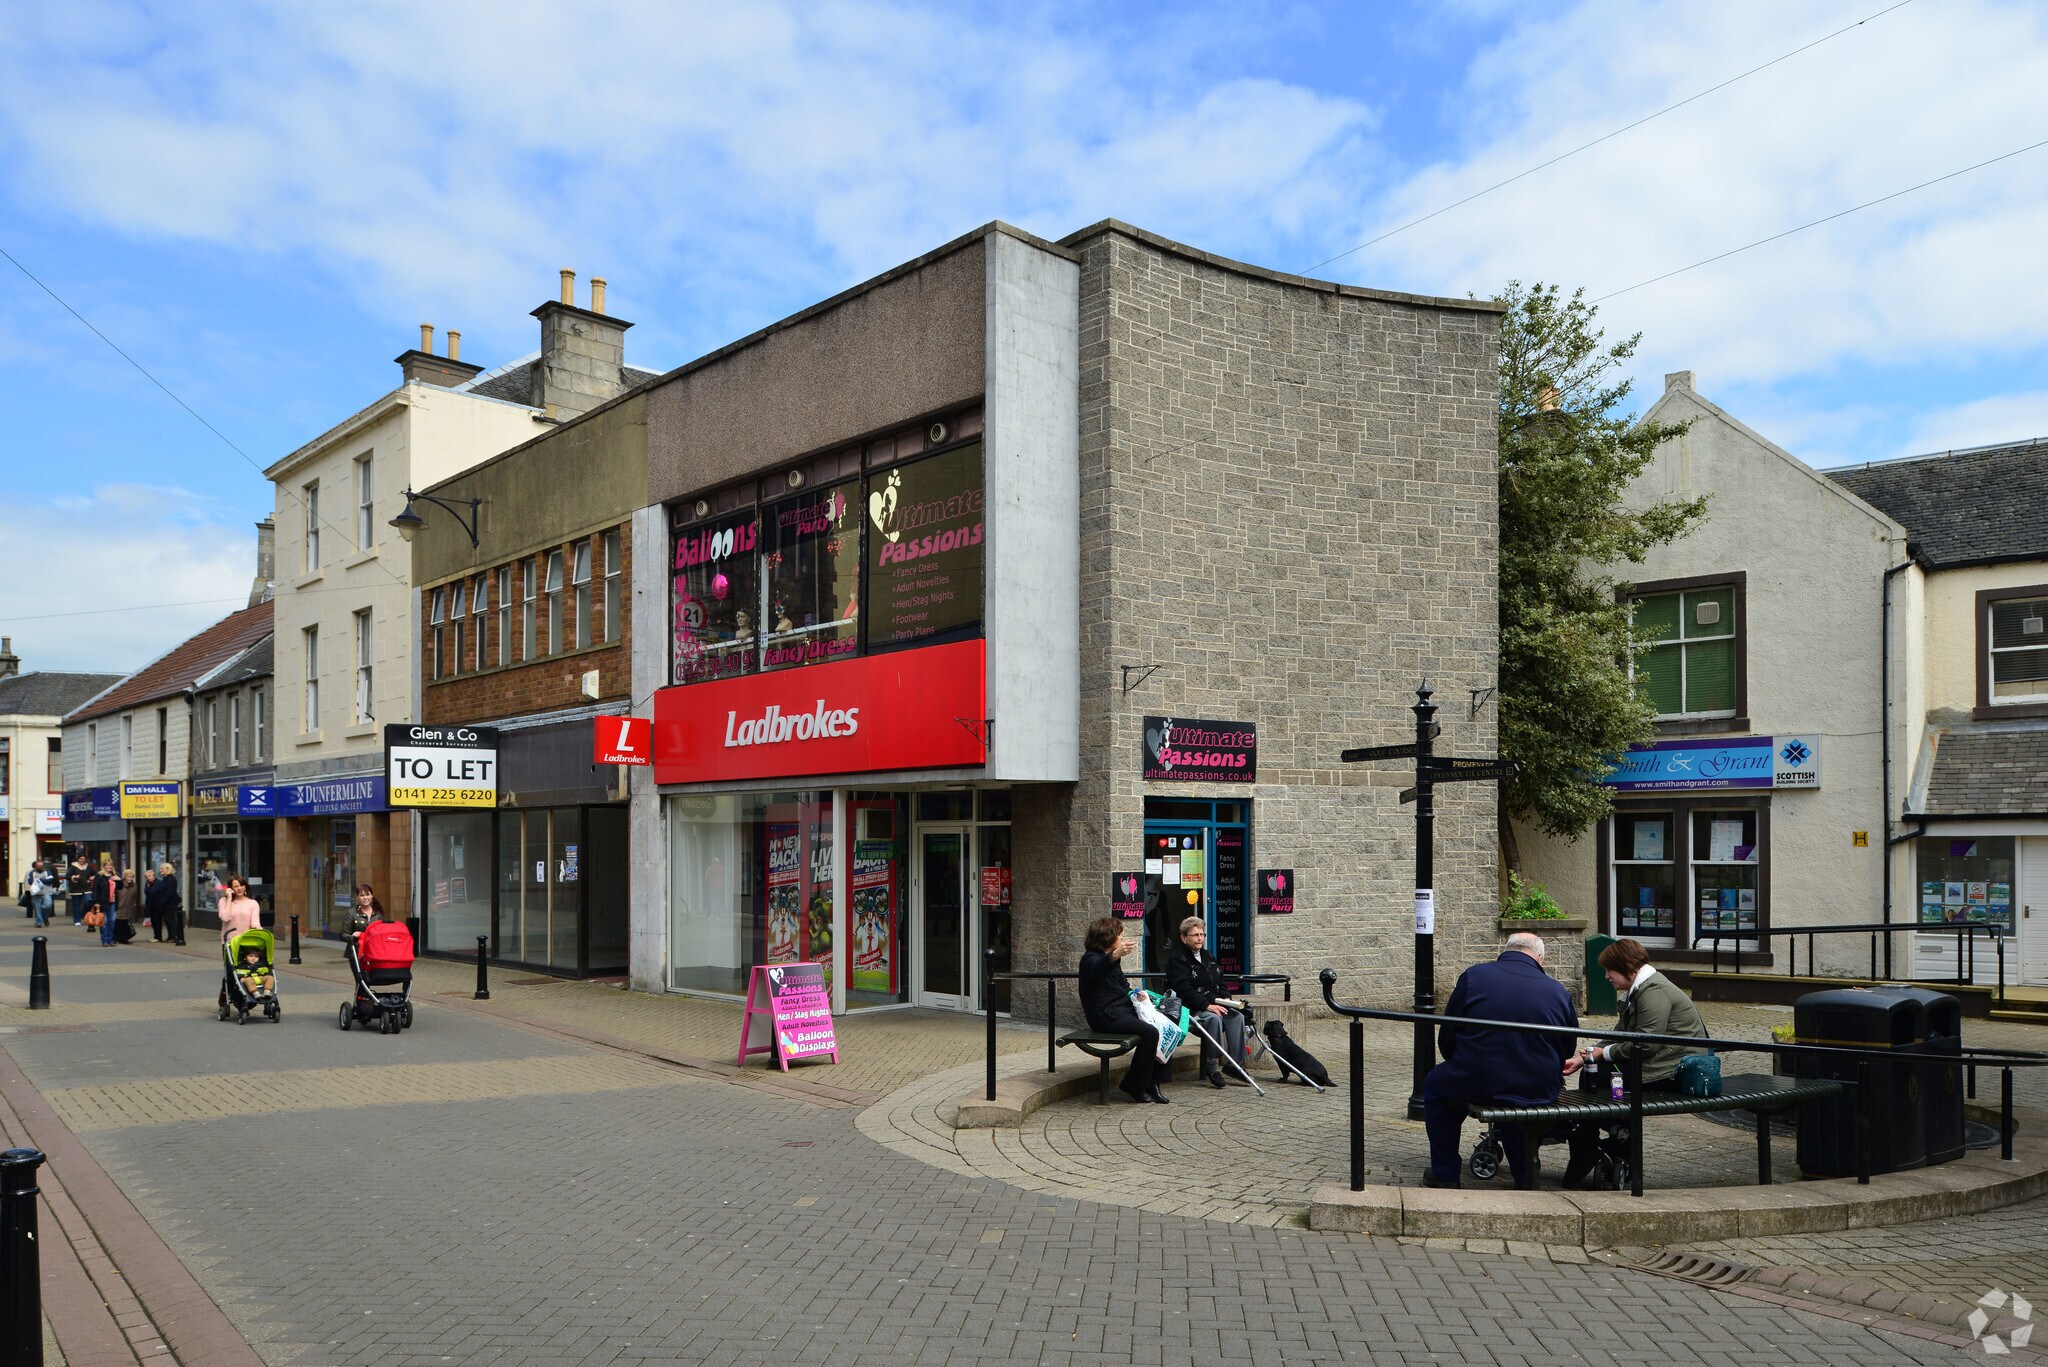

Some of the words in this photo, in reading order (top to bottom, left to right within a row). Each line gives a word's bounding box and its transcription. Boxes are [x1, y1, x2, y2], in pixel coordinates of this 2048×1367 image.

[778, 501, 831, 528] Ultimate
[882, 489, 983, 534] Ultimate
[797, 517, 829, 537] Party
[675, 520, 756, 570] Balloons
[879, 523, 983, 566] Passions
[896, 567, 918, 578] Fancy
[918, 561, 939, 573] Dress
[896, 581, 915, 593] Adult
[916, 575, 950, 589] Novelties
[896, 595, 929, 609] Hen/Stag
[930, 591, 954, 604] Nights
[684, 608, 699, 623] 21
[895, 612, 929, 624] Footwear
[895, 628, 914, 640] Party
[915, 625, 935, 637] Plans
[764, 644, 806, 666] Fancy
[808, 635, 856, 659] Dress
[675, 659, 707, 681] 01333
[708, 656, 723, 675] 30
[725, 654, 739, 672] 40
[724, 699, 860, 748] Ladbrokes
[409, 727, 442, 740] Glen
[447, 731, 455, 741] &
[457, 728, 478, 742] Co
[616, 720, 634, 752] L
[1168, 727, 1254, 748] Ultimate
[604, 753, 646, 764] Ladbrokes
[1158, 748, 1247, 767] Passions
[1667, 752, 1695, 773] &
[1698, 750, 1770, 778] Grant
[394, 758, 433, 780] TO
[447, 759, 493, 781] LET
[1145, 768, 1253, 781] ultimatepassions.co.uk
[1475, 769, 1503, 778] CENTRE
[1776, 772, 1815, 780] SCOTTISH
[1634, 779, 1729, 789] www.smithandgrant.com
[305, 781, 373, 804] DUNFERMLINE
[394, 789, 426, 799] 0141
[432, 789, 456, 800] 225
[461, 790, 492, 800] 6220
[313, 803, 340, 813] BUILDING
[340, 802, 363, 810] SOCIETY
[769, 847, 799, 869] BACK
[1219, 855, 1236, 863] Fancy
[1112, 902, 1145, 911] Ultimate
[1258, 897, 1294, 905] Ultimate
[1270, 904, 1292, 912] Party
[1123, 910, 1144, 918] Party
[1220, 936, 1235, 944] Party
[779, 973, 821, 986] Ultimate
[779, 984, 823, 995] Passions
[781, 998, 800, 1006] Fancy
[802, 995, 821, 1003] Dress
[810, 1008, 829, 1018] Nights
[782, 1022, 799, 1030] Adult
[800, 1020, 828, 1028] Novelties
[797, 1030, 833, 1042] Balloon
[799, 1040, 835, 1053] Displays
